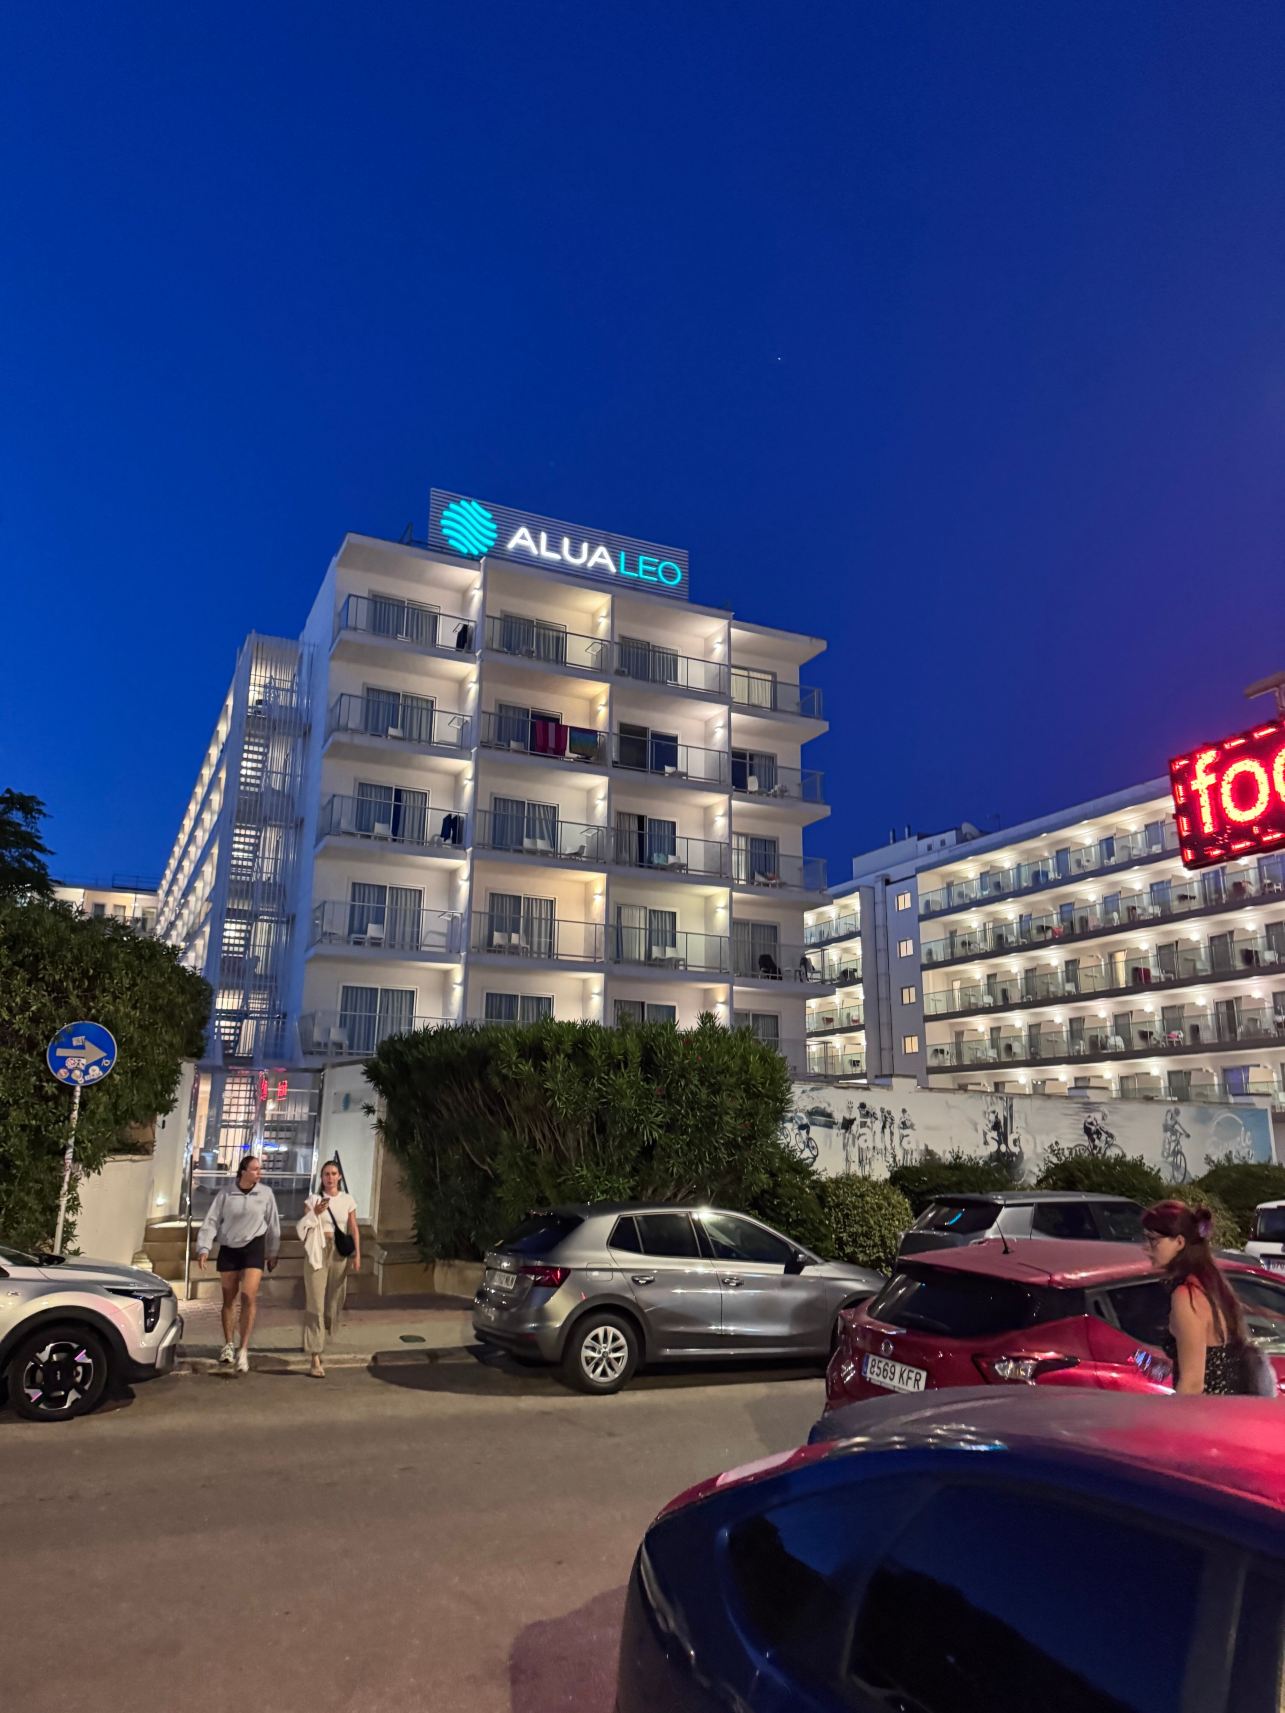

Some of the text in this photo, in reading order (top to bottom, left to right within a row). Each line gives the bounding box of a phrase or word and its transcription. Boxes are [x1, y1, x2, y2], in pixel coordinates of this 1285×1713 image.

[1191, 748, 1285, 834] fo
[869, 1358, 922, 1391] 8569 KFR
